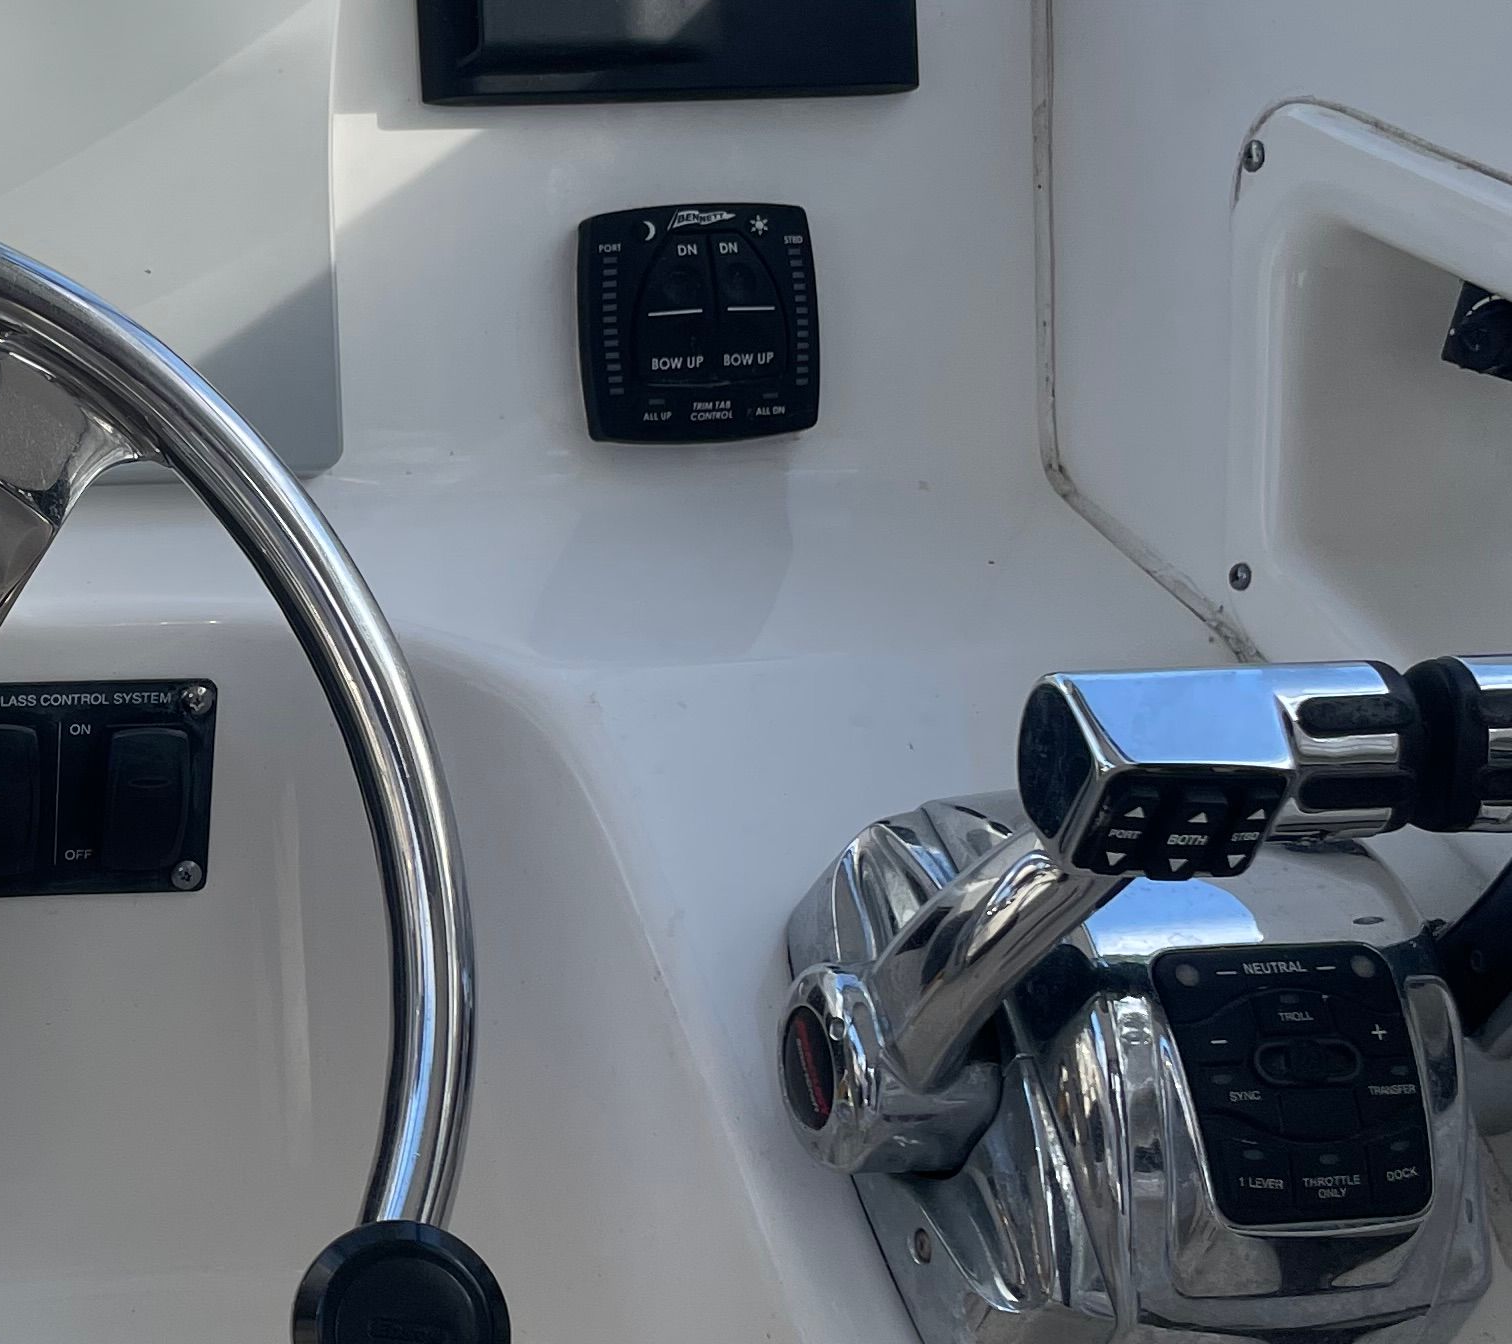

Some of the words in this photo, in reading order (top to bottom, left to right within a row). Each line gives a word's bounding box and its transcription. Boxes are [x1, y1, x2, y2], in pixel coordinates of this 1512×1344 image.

[599, 244, 621, 253] PORT
[678, 245, 697, 256] DN
[719, 242, 738, 254] DN
[652, 358, 682, 370] BOW
[687, 356, 704, 369] UP
[724, 354, 753, 366] BOW
[757, 352, 774, 364] UP
[693, 402, 713, 410] TRIM
[715, 401, 731, 409] TAB
[756, 407, 771, 416] ALL
[643, 413, 659, 421] ALL
[661, 412, 672, 421] UP
[691, 411, 733, 421] CONTROL
[41, 693, 110, 706] CONTROL
[113, 693, 172, 705] SYSTEM
[69, 724, 91, 736] ON
[1109, 828, 1142, 839] PORT
[1167, 835, 1208, 845] BOTH
[65, 849, 93, 861] OFF
[1242, 962, 1307, 975] NEUTRAL
[1278, 1012, 1314, 1022] TROLL
[1229, 1090, 1262, 1102] SYNC
[1368, 1085, 1416, 1095] TRANSFER
[1387, 1166, 1418, 1181] DOCK
[1249, 1177, 1284, 1189] LEVER
[1302, 1174, 1360, 1187] THROTTLE
[1318, 1188, 1347, 1198] ONLY
